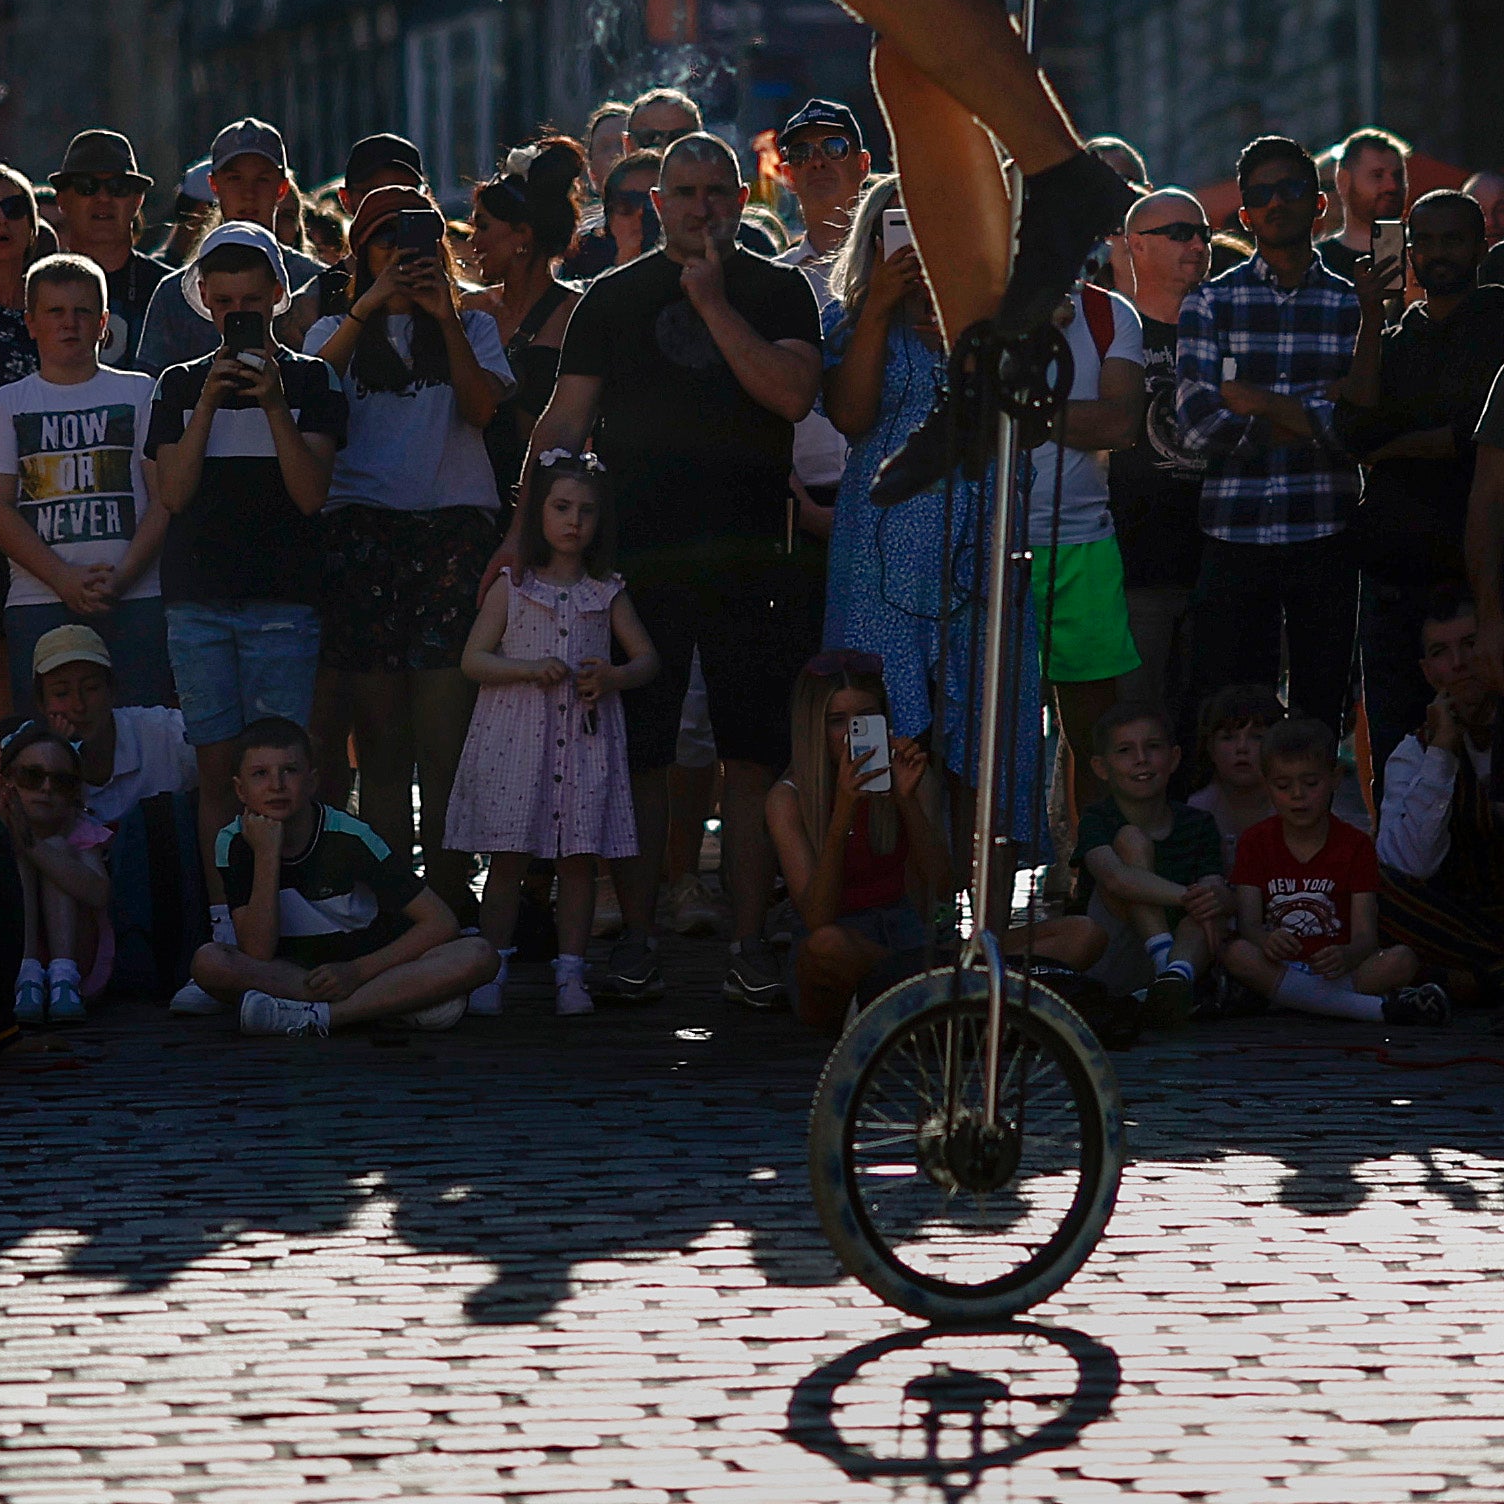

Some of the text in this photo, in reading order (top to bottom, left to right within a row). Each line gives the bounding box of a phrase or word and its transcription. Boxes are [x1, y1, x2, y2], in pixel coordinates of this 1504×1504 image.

[40, 410, 108, 450] NOW
[58, 455, 96, 492] OR
[36, 500, 122, 542] NEVER
[1268, 878, 1336, 895] NEW YORK
